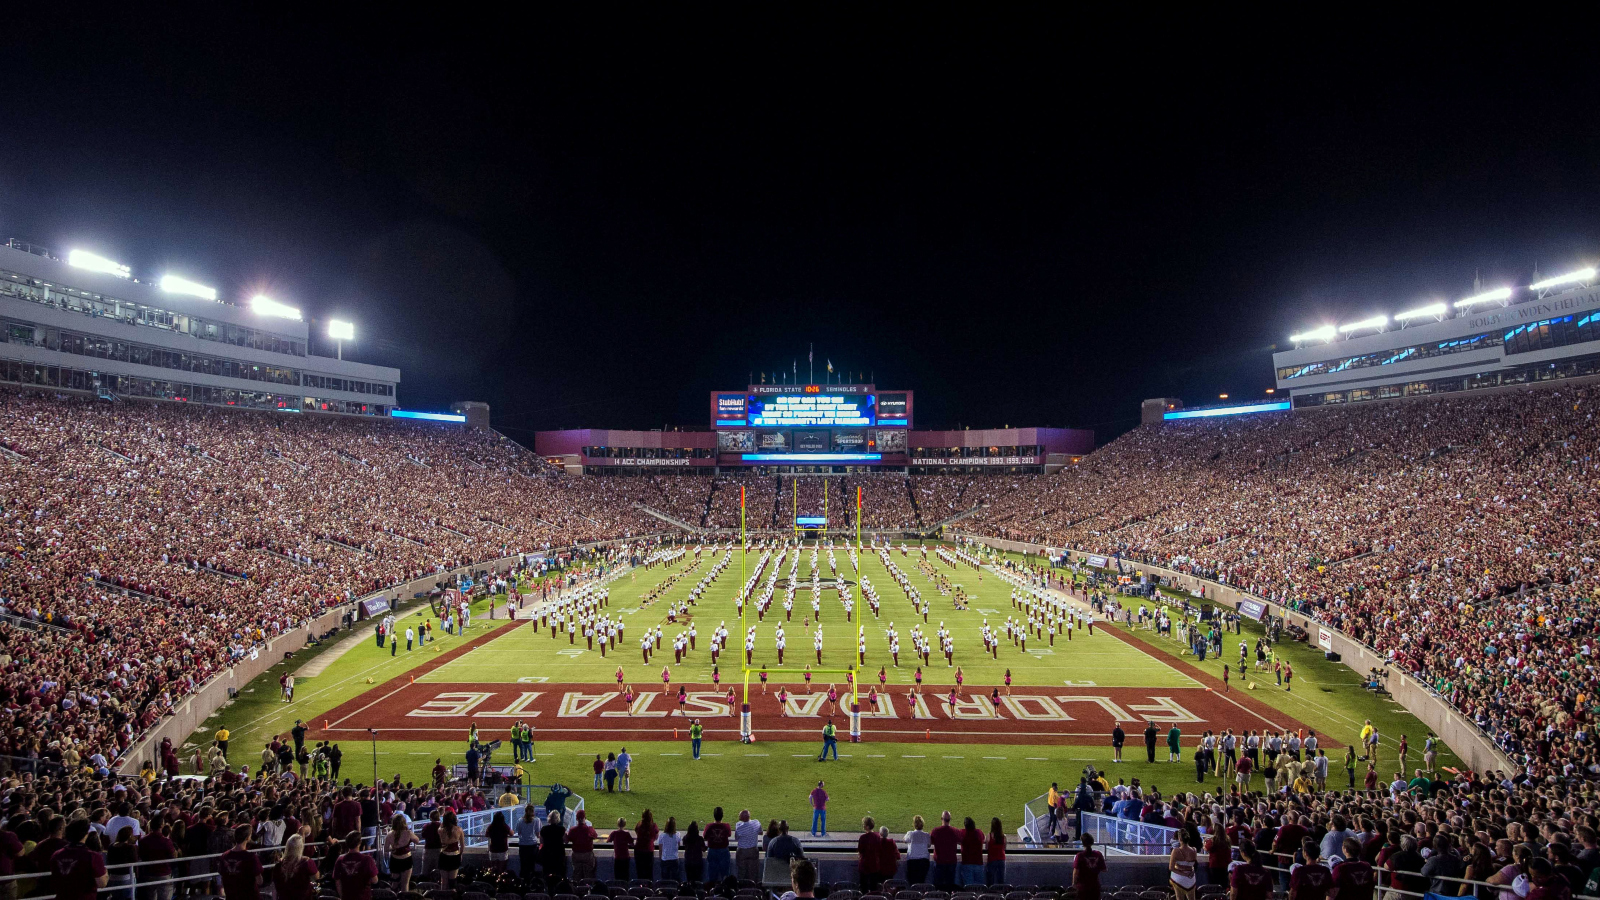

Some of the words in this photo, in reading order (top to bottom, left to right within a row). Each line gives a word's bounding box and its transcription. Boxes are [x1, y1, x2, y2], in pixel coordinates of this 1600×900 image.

[1470, 315, 1500, 328] BOBBY
[405, 691, 738, 718] STATE
[775, 691, 1208, 723] FLORIDA
